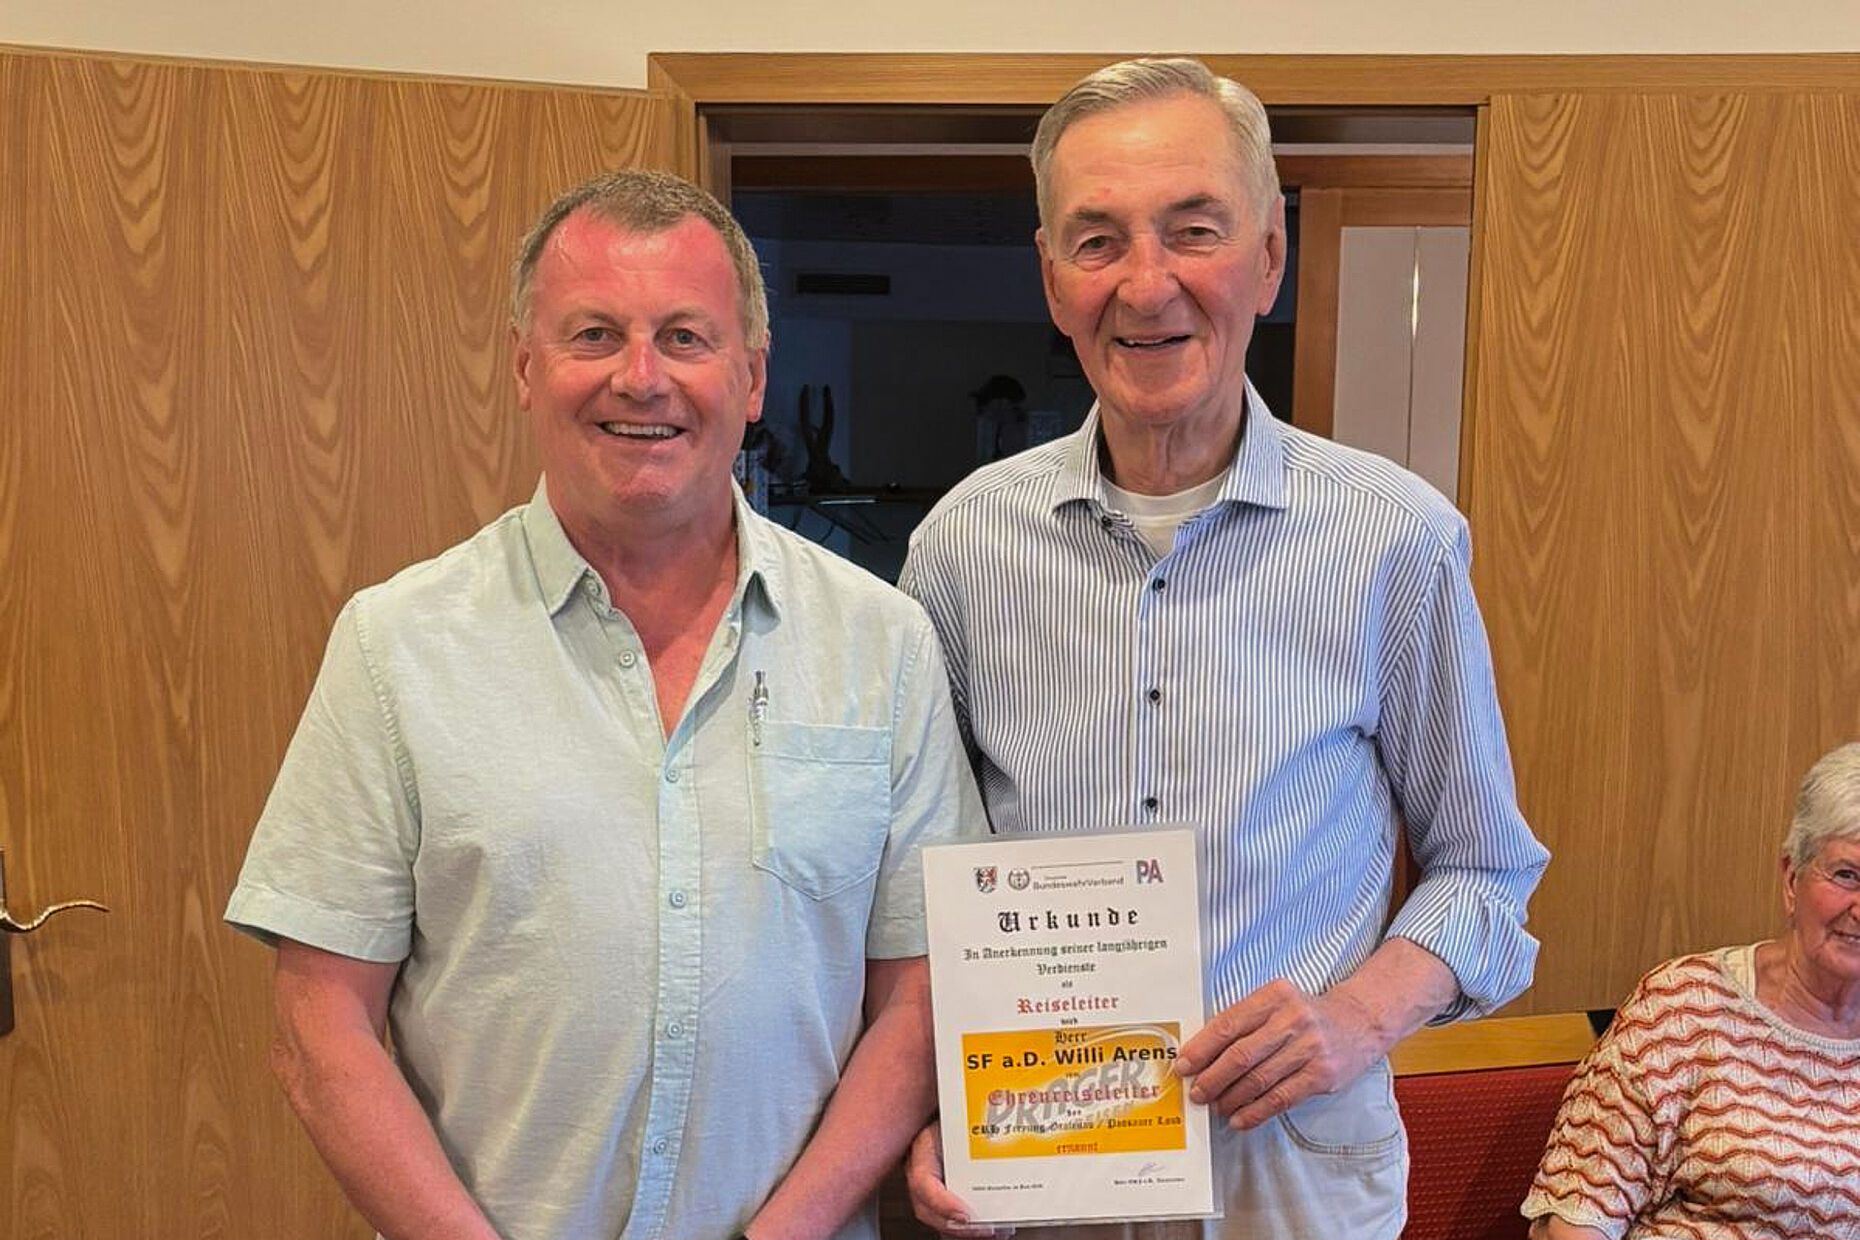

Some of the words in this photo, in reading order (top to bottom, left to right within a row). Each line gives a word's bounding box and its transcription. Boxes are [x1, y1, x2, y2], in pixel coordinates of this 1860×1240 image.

[1135, 858, 1164, 885] PA
[997, 907, 1140, 933] Urkunde
[983, 944, 1058, 961] Anerkennung
[1060, 942, 1094, 956] seiner
[1036, 961, 1097, 976] Verdienste
[1016, 995, 1120, 1015] Reiseleiter
[967, 1053, 993, 1070] SF
[1002, 1051, 1046, 1068] a.D.
[1055, 1046, 1104, 1065] Willi
[1113, 1046, 1178, 1063] Arens
[988, 1082, 1161, 1107] Ehrenreiseleiter
